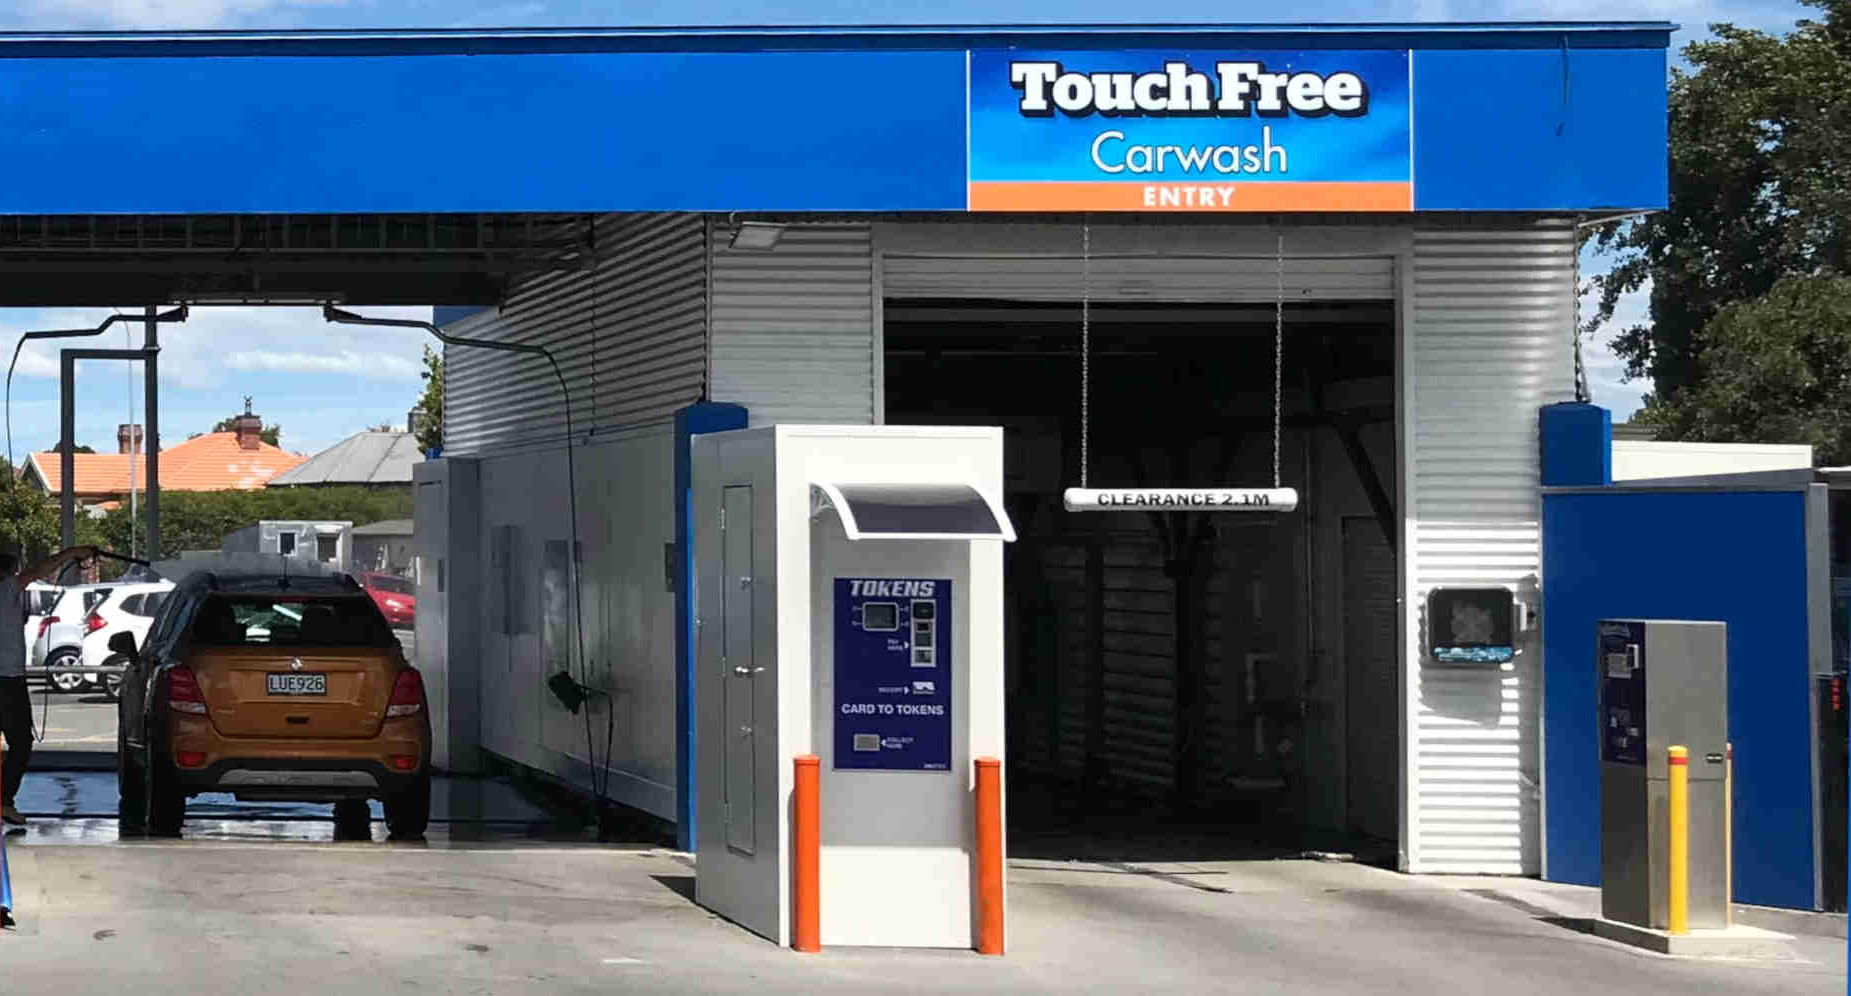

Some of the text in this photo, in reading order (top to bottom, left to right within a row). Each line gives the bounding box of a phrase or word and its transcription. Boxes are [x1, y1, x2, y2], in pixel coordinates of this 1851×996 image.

[1011, 62, 1366, 114] Touch Free
[1091, 126, 1287, 173] Carwash
[1144, 186, 1235, 206] ENTRY
[1098, 493, 1270, 506] CLEARANCE 2.1M
[851, 580, 935, 597] TOKENS
[841, 703, 944, 715] CARD TO TOKENS
